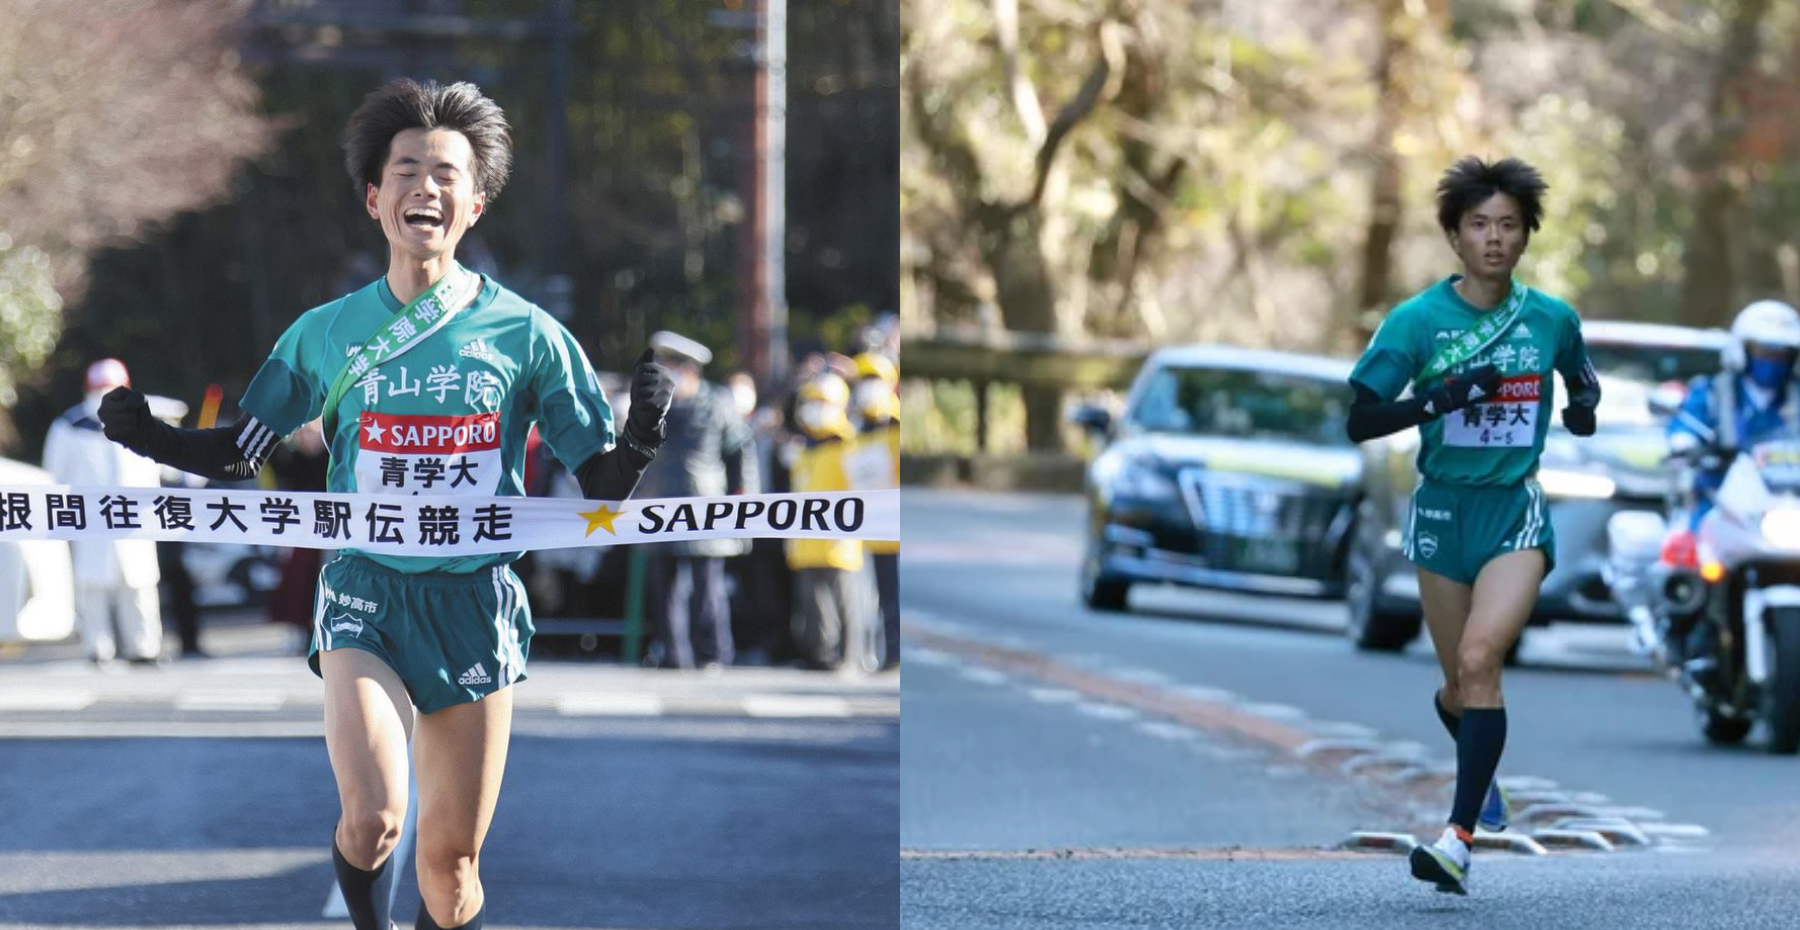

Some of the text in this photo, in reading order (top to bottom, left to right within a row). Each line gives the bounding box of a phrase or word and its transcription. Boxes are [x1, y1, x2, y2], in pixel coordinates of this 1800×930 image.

[354, 364, 502, 408] 青山学院
[391, 421, 496, 448] SAPPORO
[379, 455, 480, 489] 青学大
[638, 497, 865, 535] SAPPORO
[458, 674, 492, 686] adidas
